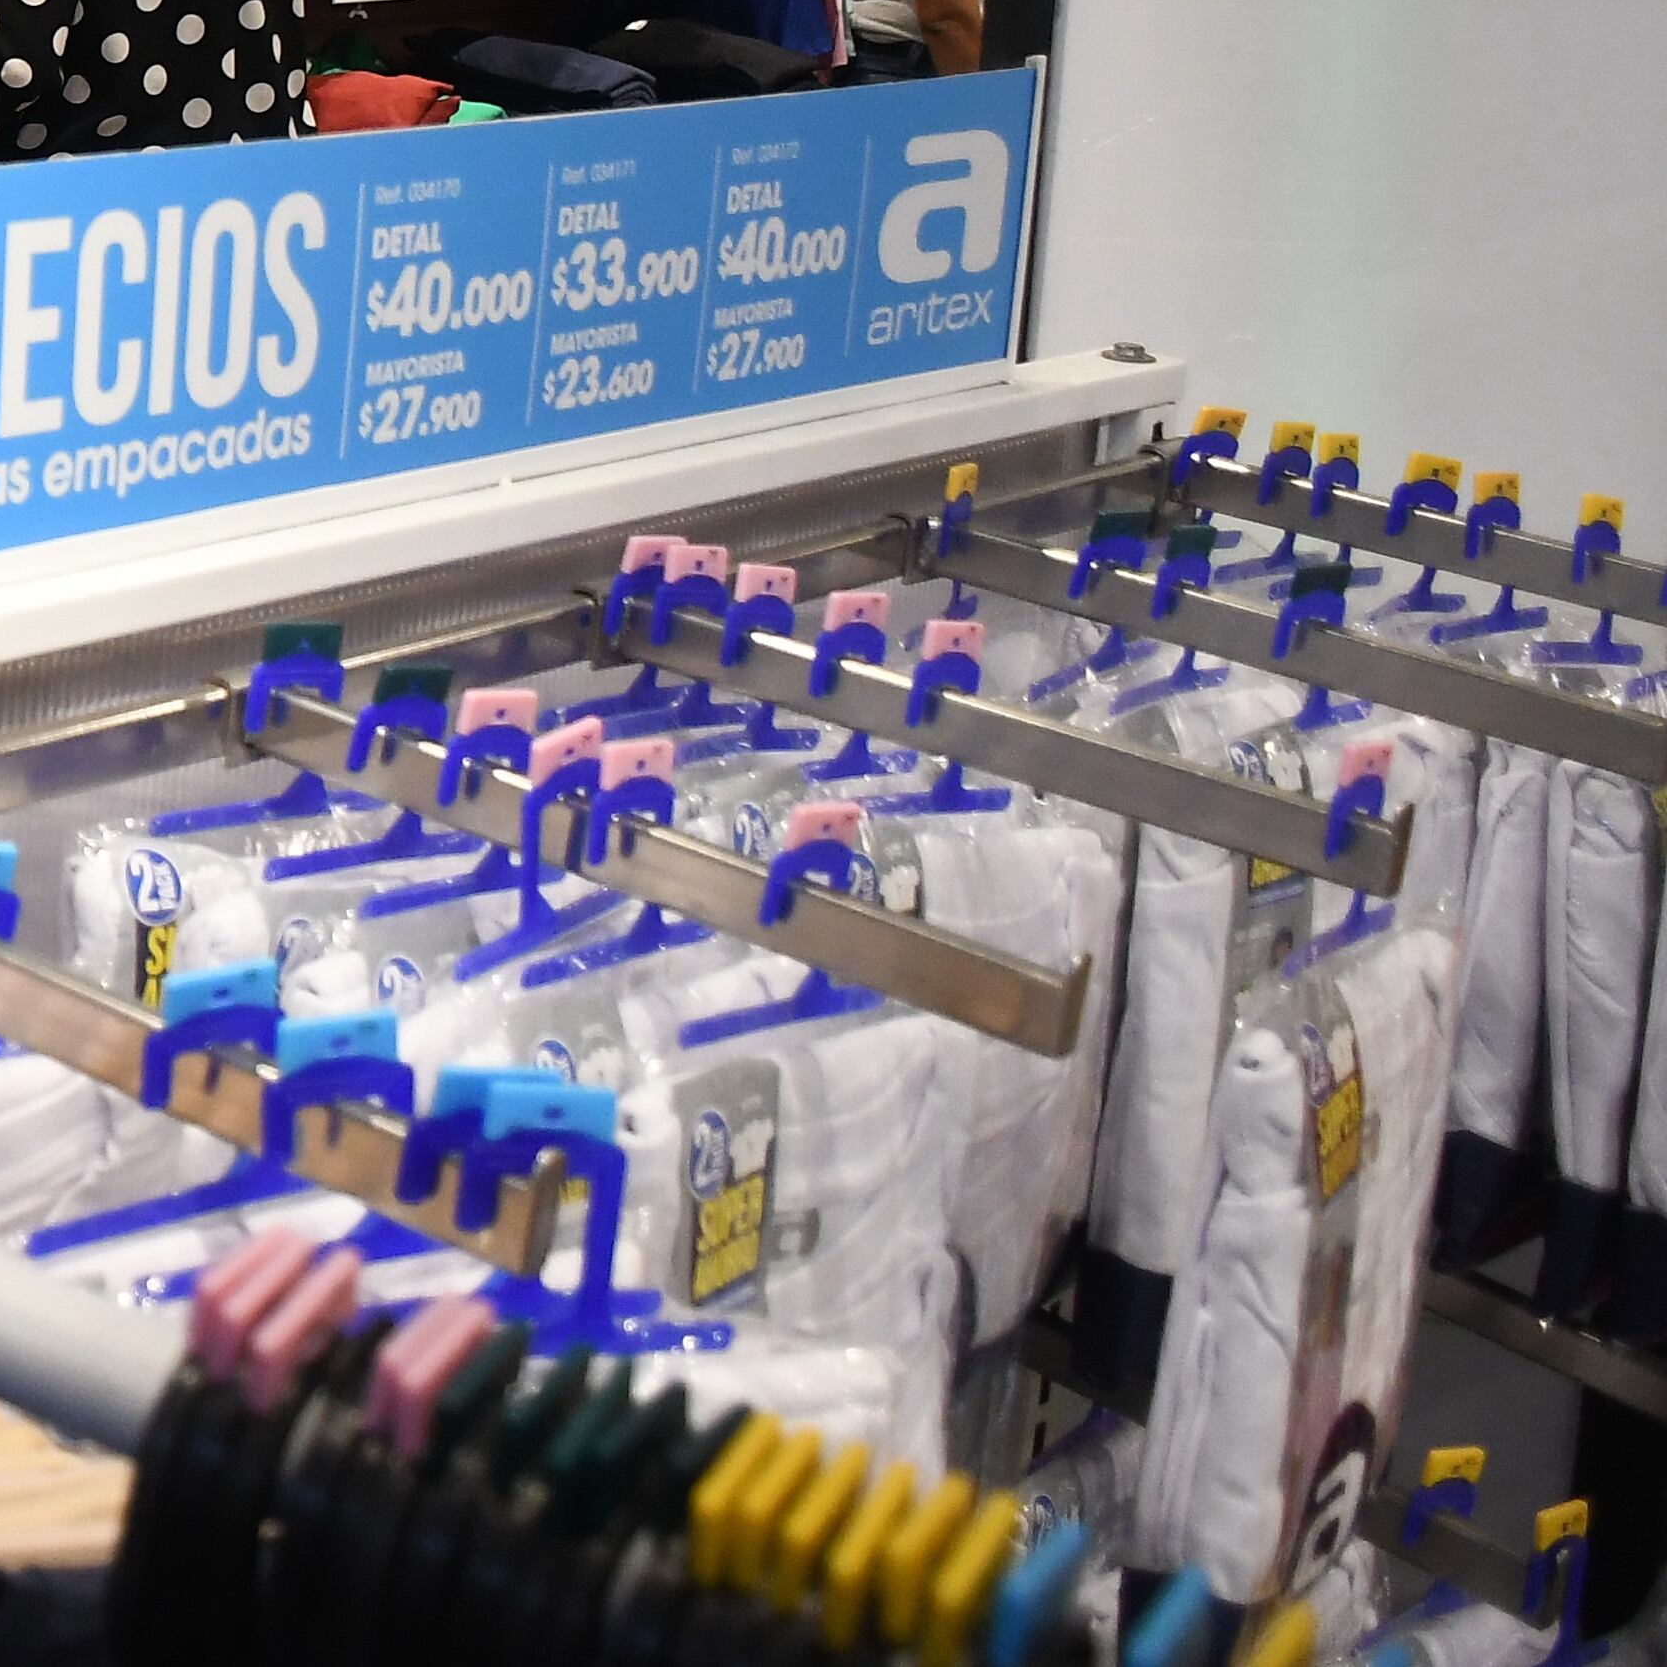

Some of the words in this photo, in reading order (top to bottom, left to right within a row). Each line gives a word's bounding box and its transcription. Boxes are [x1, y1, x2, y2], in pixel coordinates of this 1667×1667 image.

[558, 202, 621, 236] DETAL
[726, 182, 783, 215] DETAL
[877, 129, 1010, 284] a
[371, 221, 442, 260] DETAL
[717, 216, 847, 285] $40.000
[367, 260, 533, 338] $40.000
[552, 237, 699, 312] $33.900
[550, 322, 638, 357] MAYORISTA
[715, 297, 794, 329] MAYORISTA
[867, 289, 994, 346] aritex
[365, 350, 465, 386] MAYORISTA
[543, 354, 655, 410] $23.600
[707, 329, 805, 381] $27.900
[358, 384, 482, 445] $27.900
[42, 410, 313, 499] empacadas
